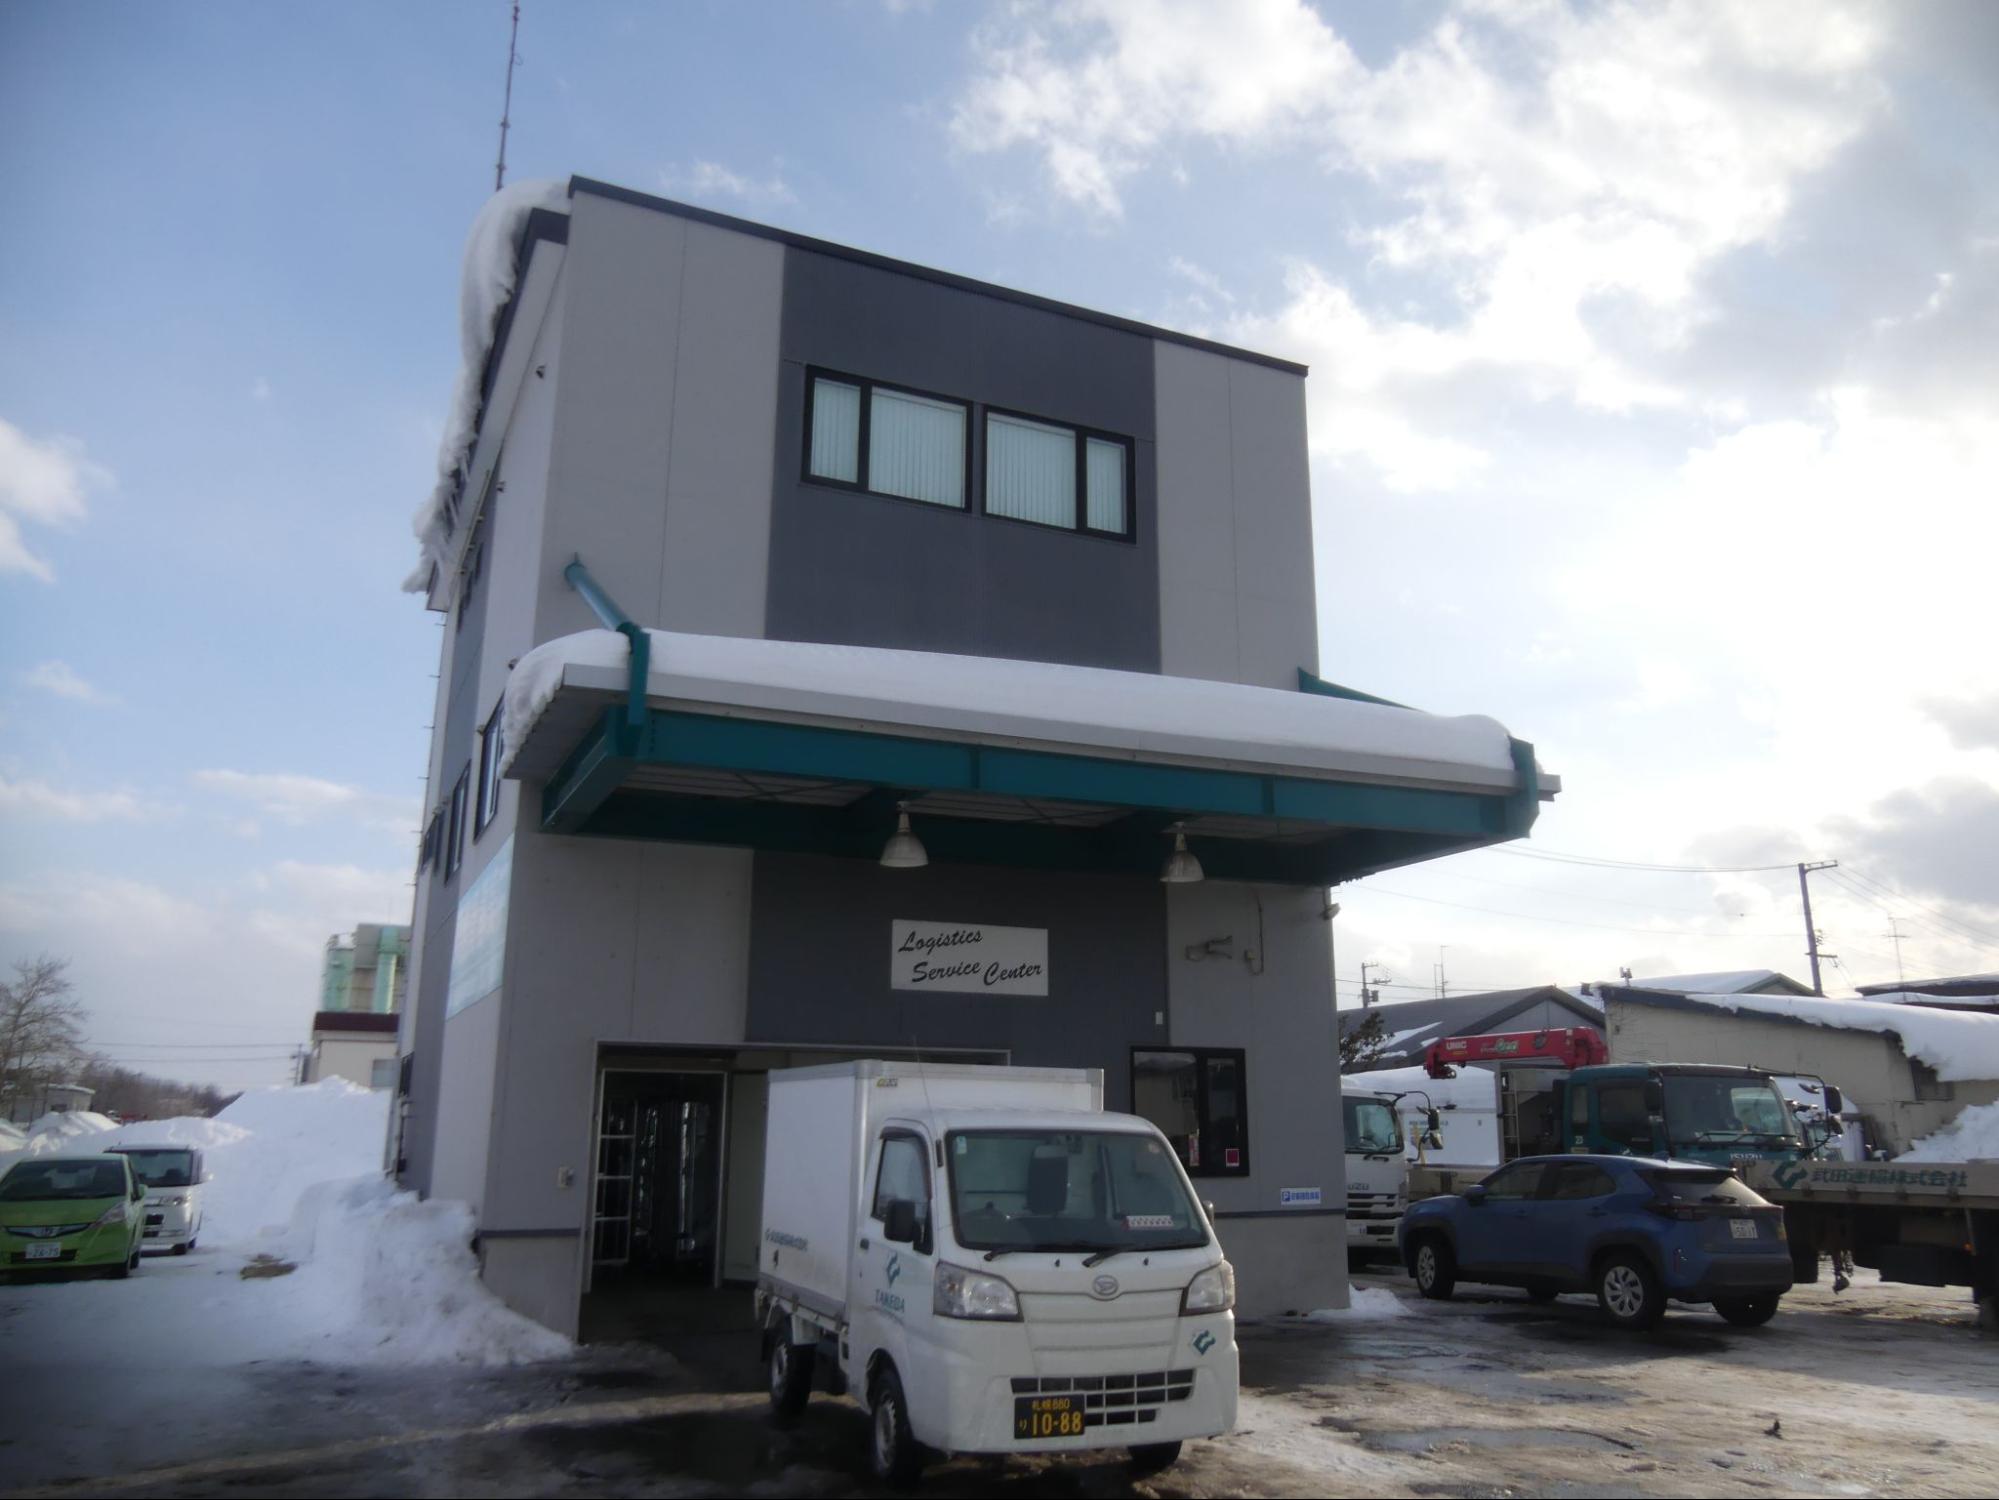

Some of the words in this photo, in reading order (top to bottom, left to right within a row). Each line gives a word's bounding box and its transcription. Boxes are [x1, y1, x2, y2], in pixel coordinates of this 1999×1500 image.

[898, 930, 982, 955] Logistics
[911, 961, 981, 982] Service
[983, 961, 1042, 986] Center
[1446, 1041, 1467, 1050] UNIC
[875, 1289, 905, 1313] TAKEDA
[1032, 1410, 1082, 1436] 10-88
